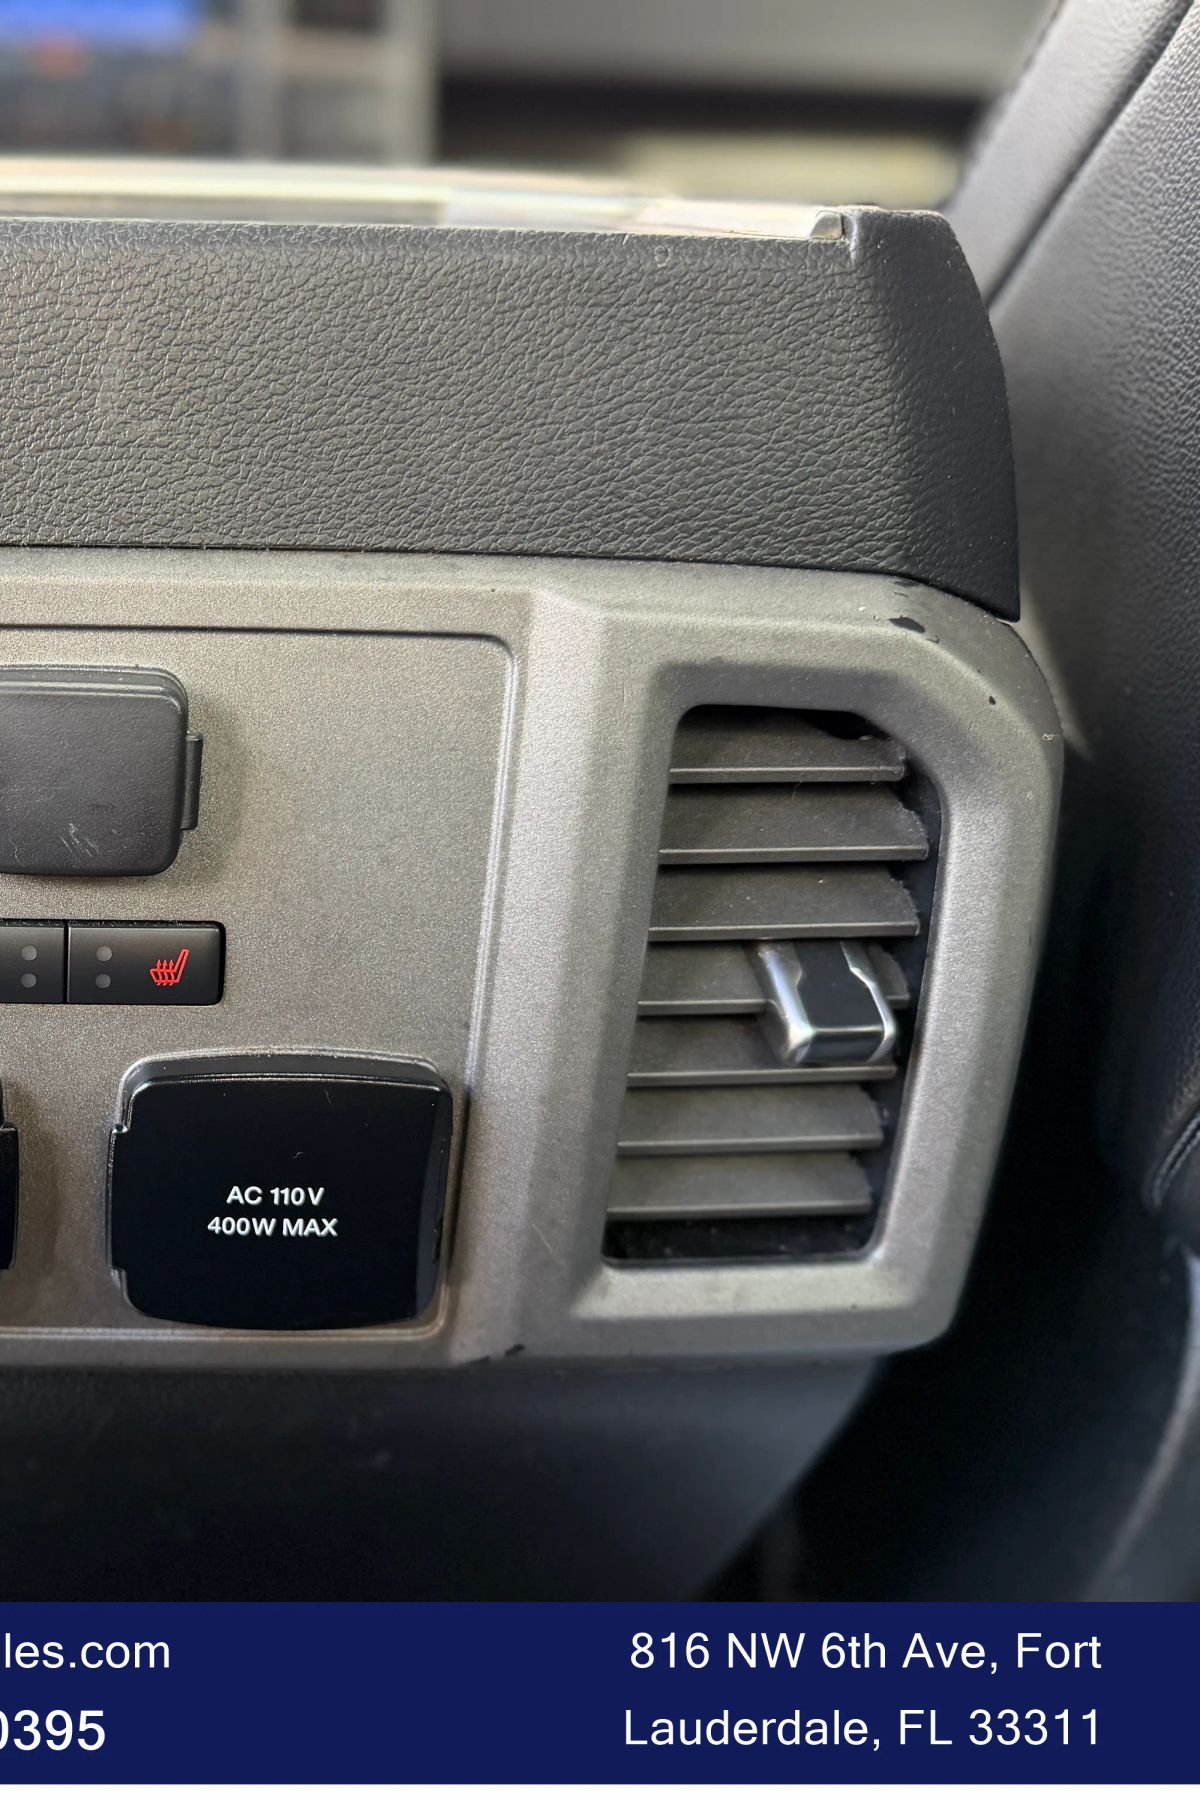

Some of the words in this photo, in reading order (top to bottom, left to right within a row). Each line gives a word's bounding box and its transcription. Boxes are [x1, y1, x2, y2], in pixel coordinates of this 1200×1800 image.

[226, 1186, 263, 1205] AC
[207, 1216, 276, 1236] 400W
[282, 1218, 338, 1237] MAX
